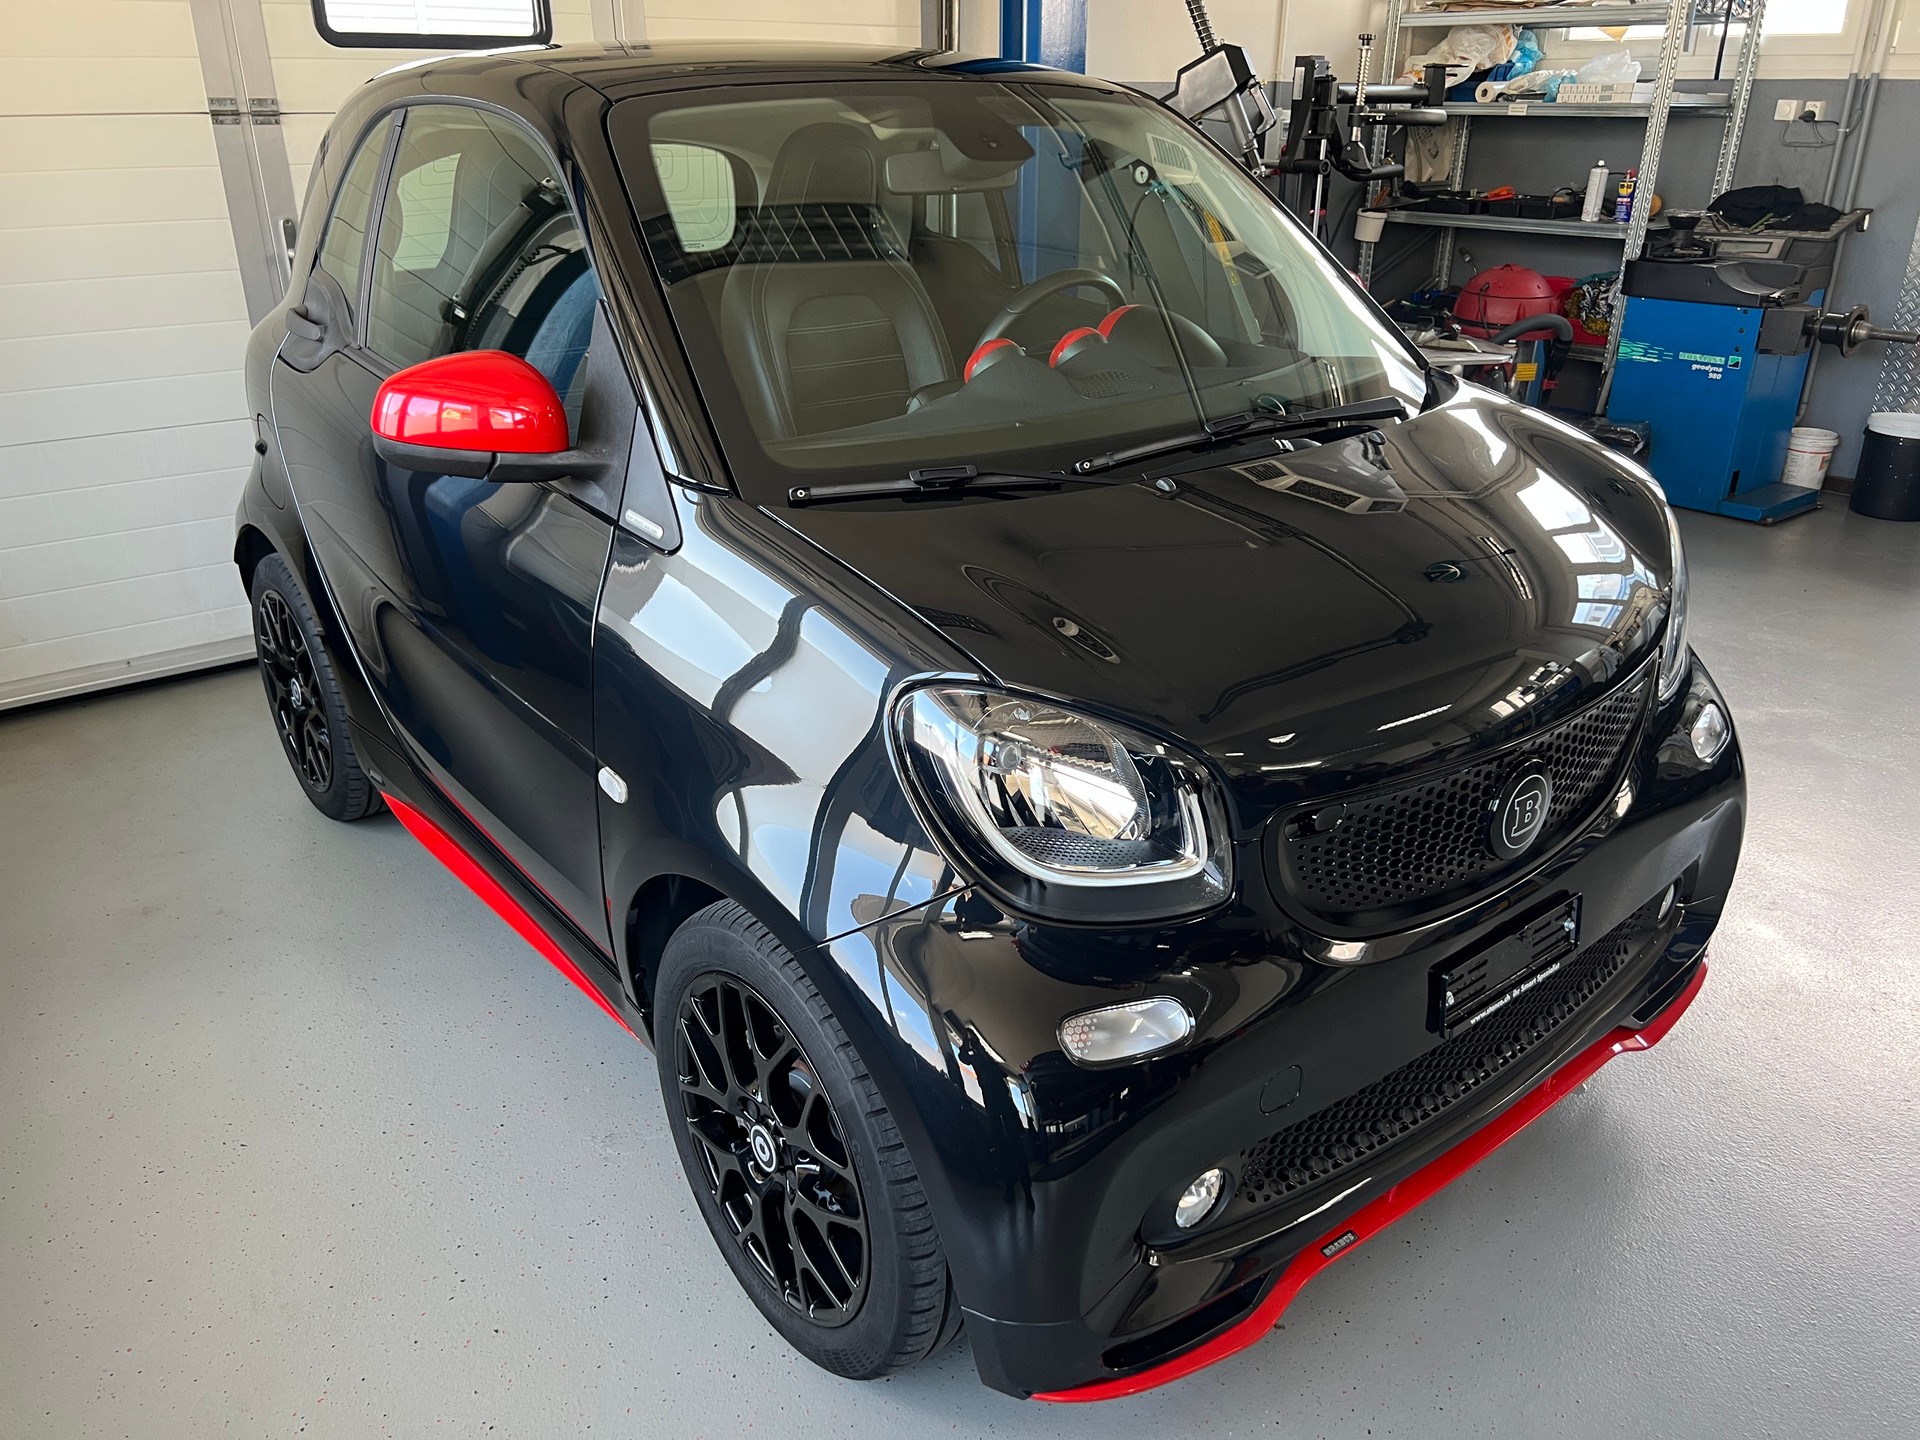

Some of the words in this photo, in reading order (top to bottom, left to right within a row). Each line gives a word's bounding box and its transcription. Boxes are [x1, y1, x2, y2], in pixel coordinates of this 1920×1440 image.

[1691, 363, 1723, 373] geodyna
[1511, 790, 1542, 837] B
[1521, 977, 1537, 992] Smart
[1322, 1232, 1355, 1256] BRABUS
